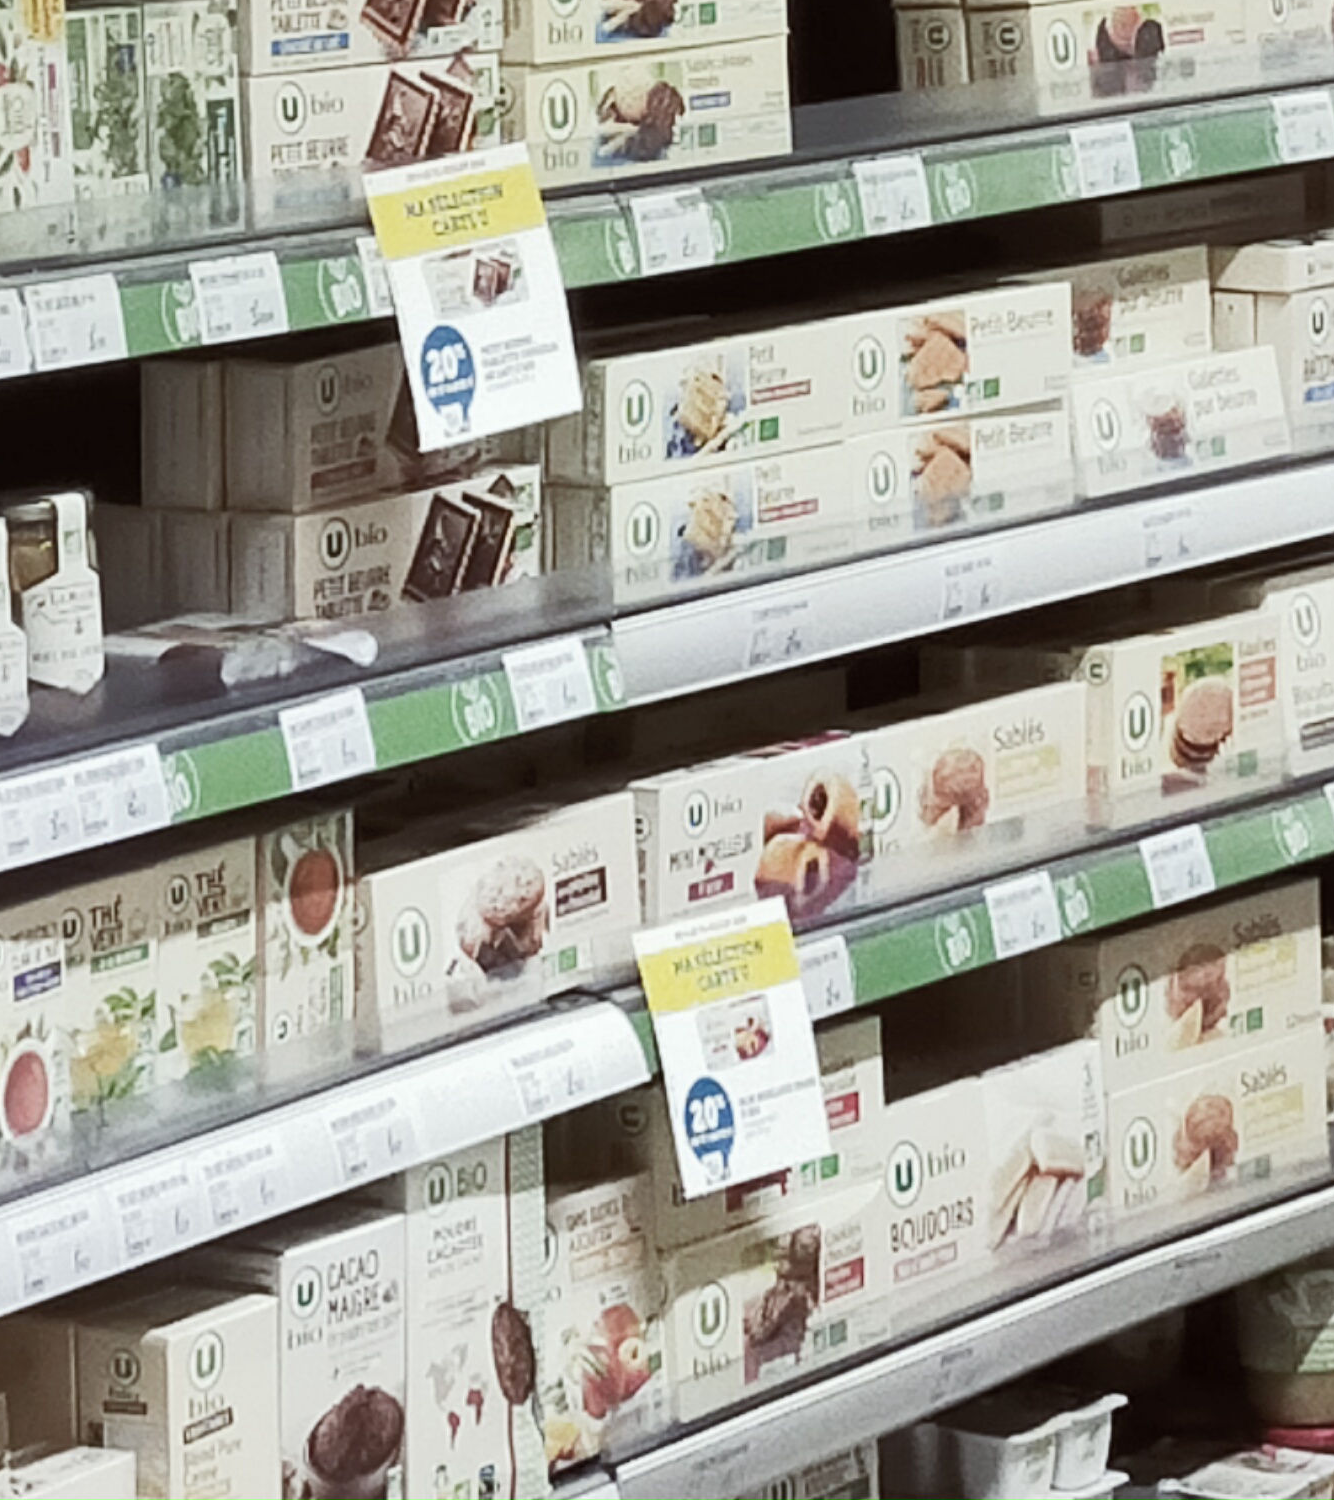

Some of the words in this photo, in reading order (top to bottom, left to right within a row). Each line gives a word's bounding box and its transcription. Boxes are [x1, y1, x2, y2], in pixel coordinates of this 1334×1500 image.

[548, 23, 583, 46] bio
[852, 395, 887, 416] bio
[618, 441, 652, 463] bio
[356, 522, 389, 548] bio
[992, 720, 1047, 753] Sablés
[1128, 706, 1146, 736] U
[196, 861, 226, 894] THÉ
[88, 894, 123, 925] THÉ
[1231, 915, 1285, 947] Sablés
[1113, 1029, 1151, 1058] bio
[1239, 1063, 1288, 1096] Sablés
[1128, 1136, 1149, 1168] U
[894, 1161, 915, 1192] U
[926, 1144, 967, 1179] bio
[889, 1198, 975, 1253] BOUDOIRS
[326, 1249, 380, 1292] CACAO
[297, 1280, 315, 1306] U
[700, 1298, 721, 1331] U
[286, 1324, 323, 1349] bio
[196, 1345, 216, 1378] U
[692, 1353, 731, 1380] bio
